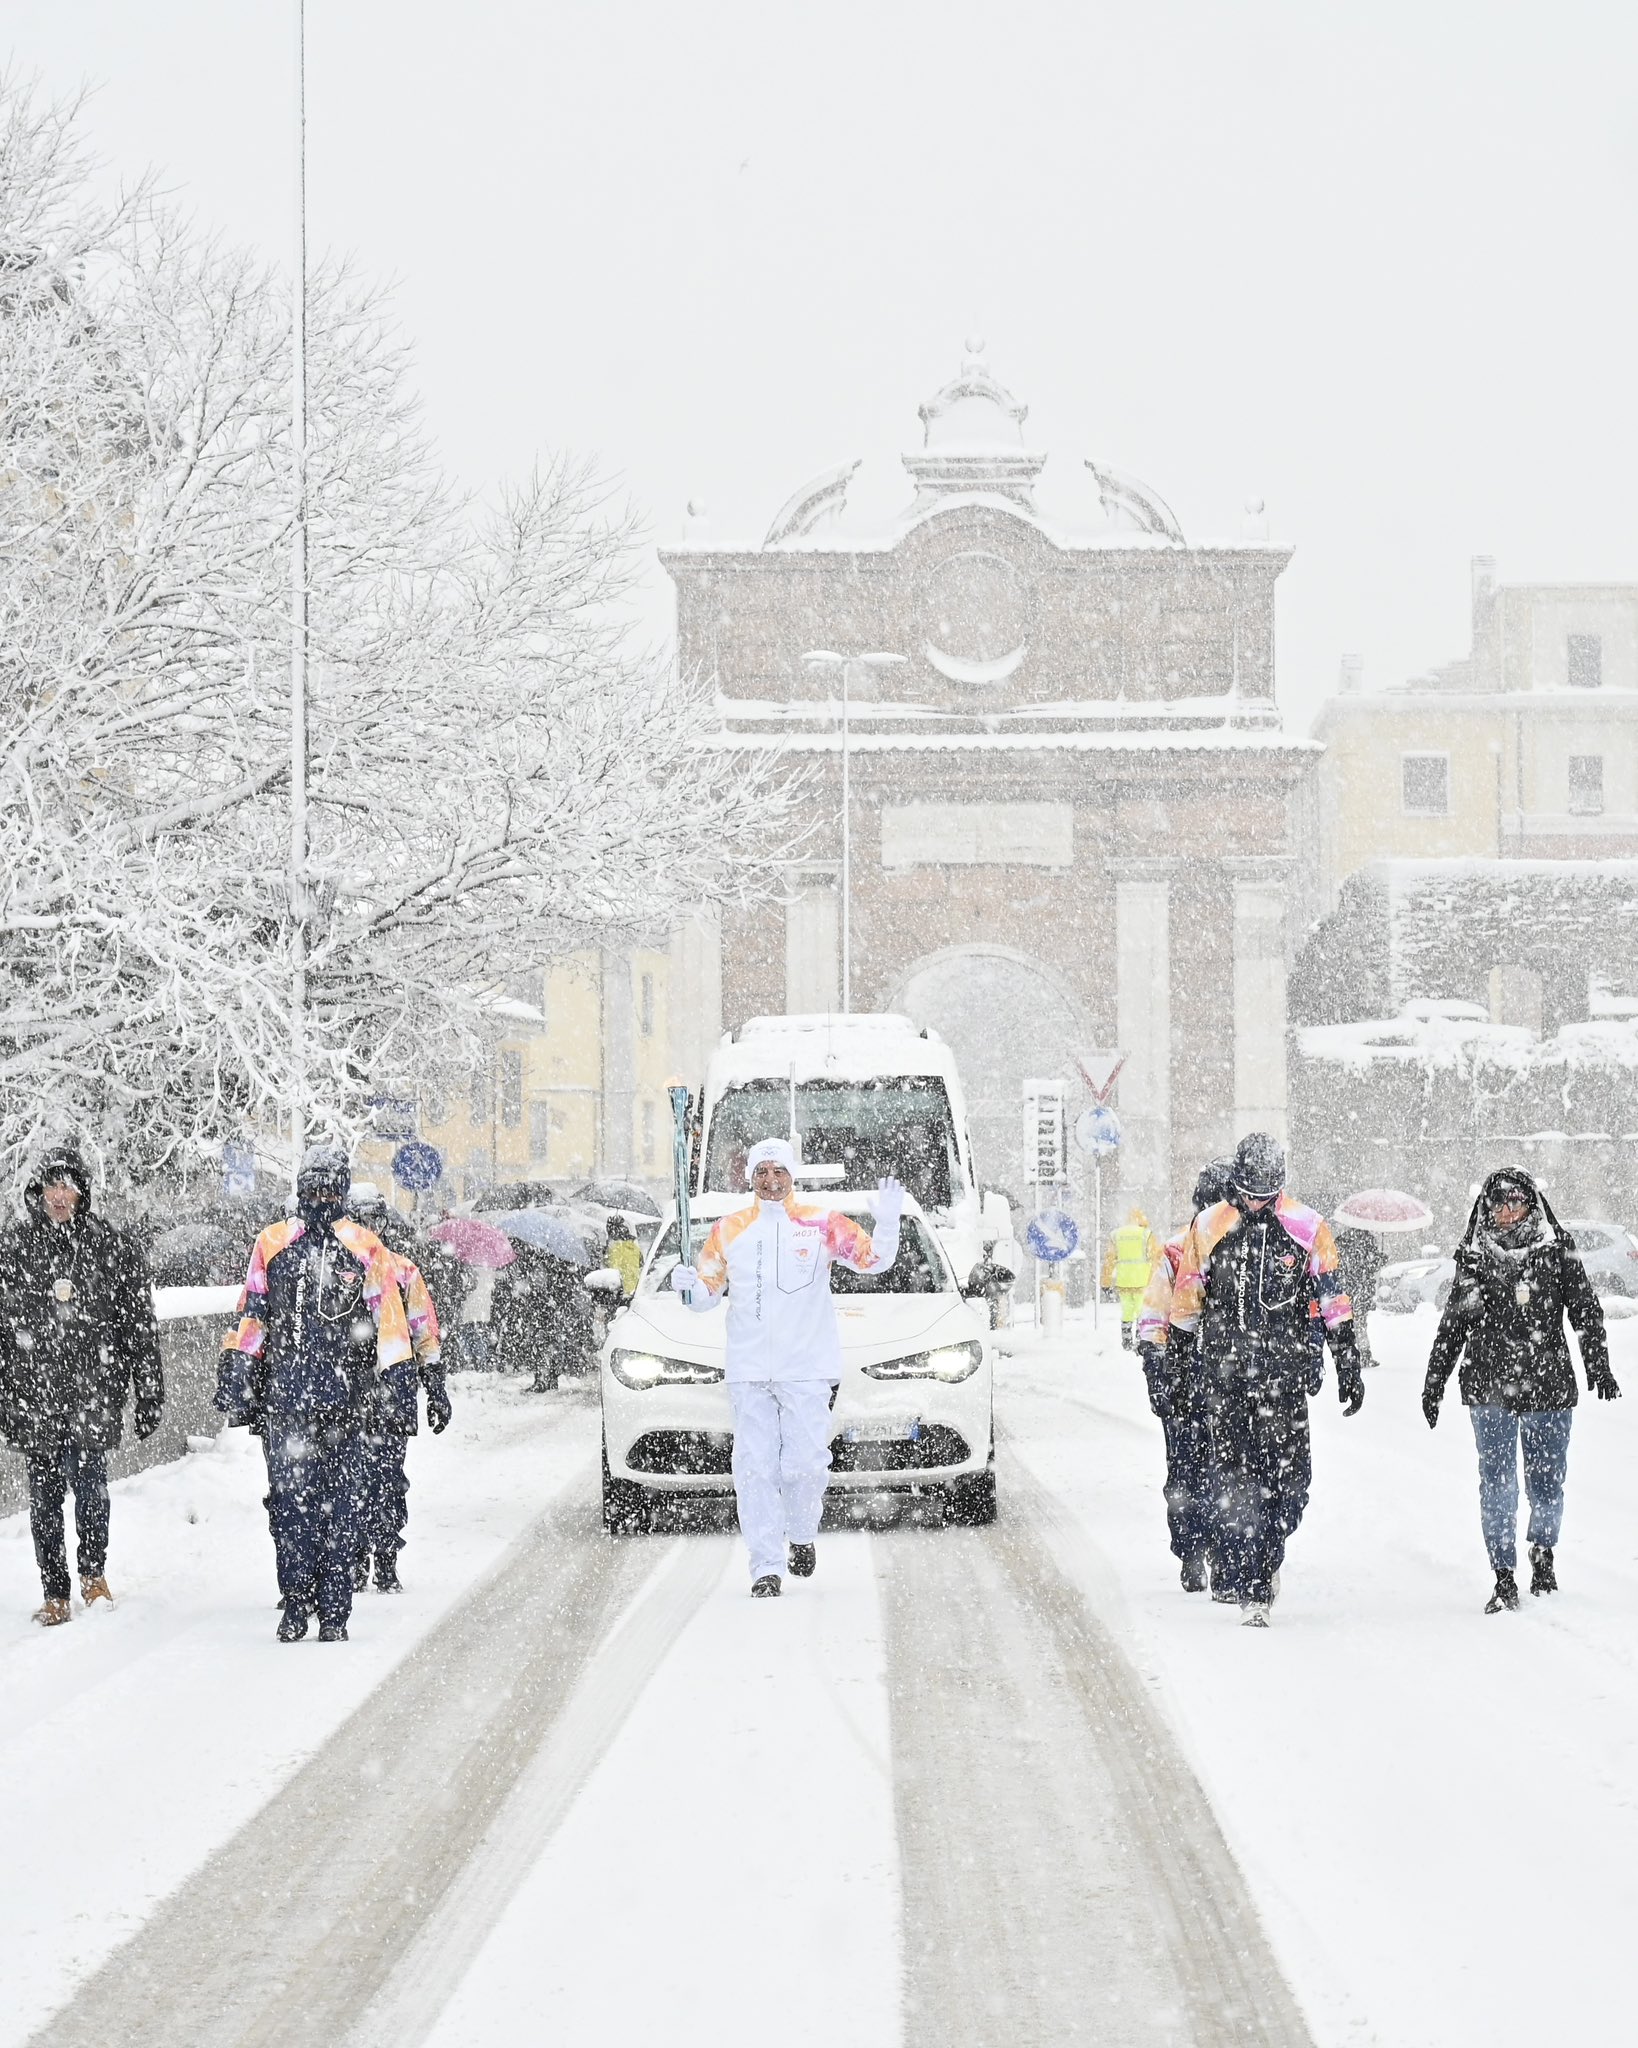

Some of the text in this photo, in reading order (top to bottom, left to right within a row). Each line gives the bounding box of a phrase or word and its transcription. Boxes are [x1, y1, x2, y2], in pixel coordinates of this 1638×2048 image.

[1241, 1241, 1249, 1260] 2026
[295, 1276, 306, 1313] CORTINA
[1238, 1261, 1248, 1297] CORTINA
[293, 1313, 303, 1349] MILANO
